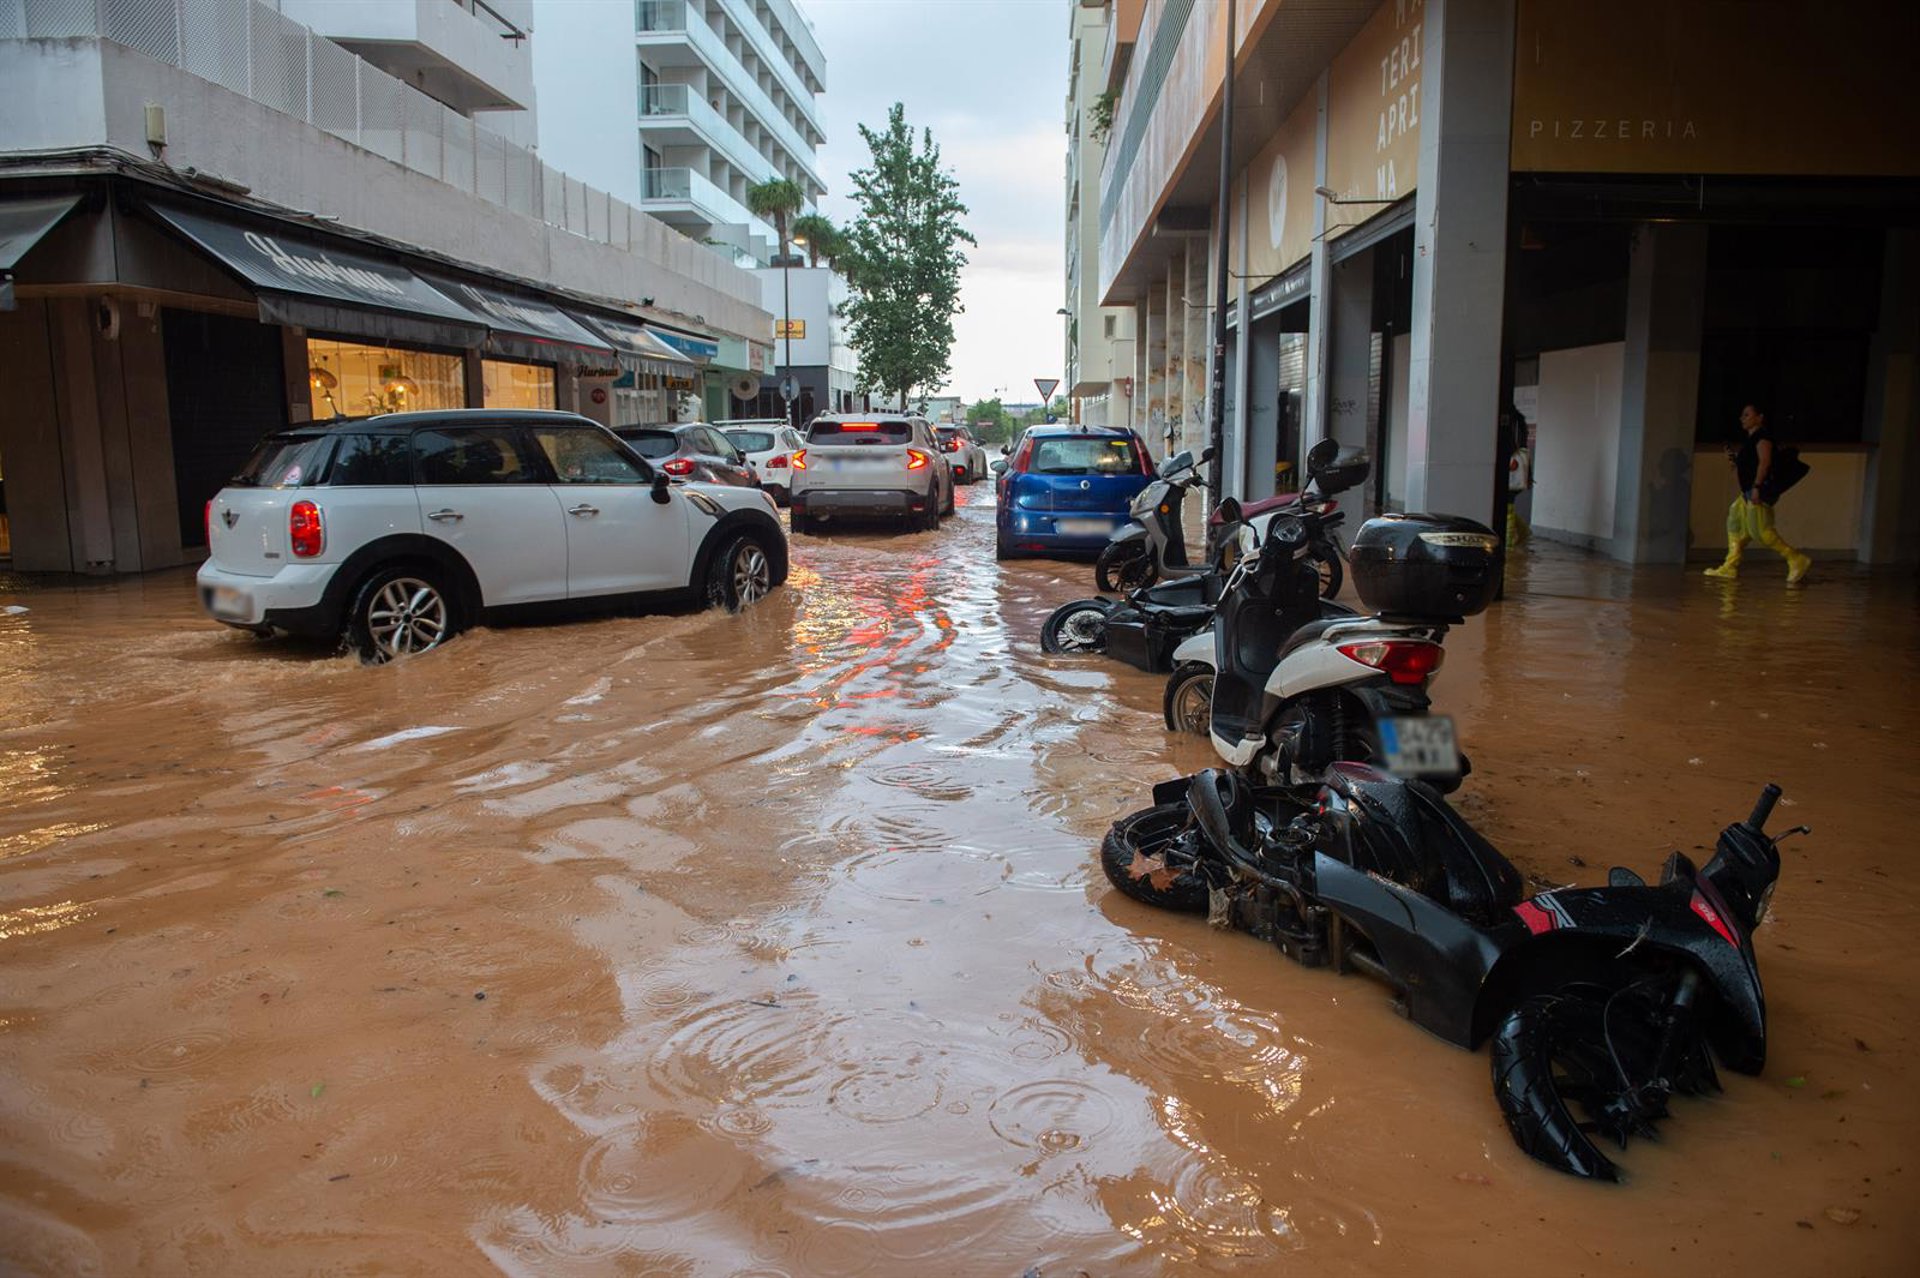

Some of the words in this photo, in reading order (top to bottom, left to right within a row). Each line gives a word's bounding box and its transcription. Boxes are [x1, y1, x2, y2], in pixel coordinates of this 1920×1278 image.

[1381, 24, 1421, 97] TERI
[1376, 83, 1418, 154] APRI
[1530, 120, 1698, 138] PIZZERIA
[1376, 159, 1397, 203] MA
